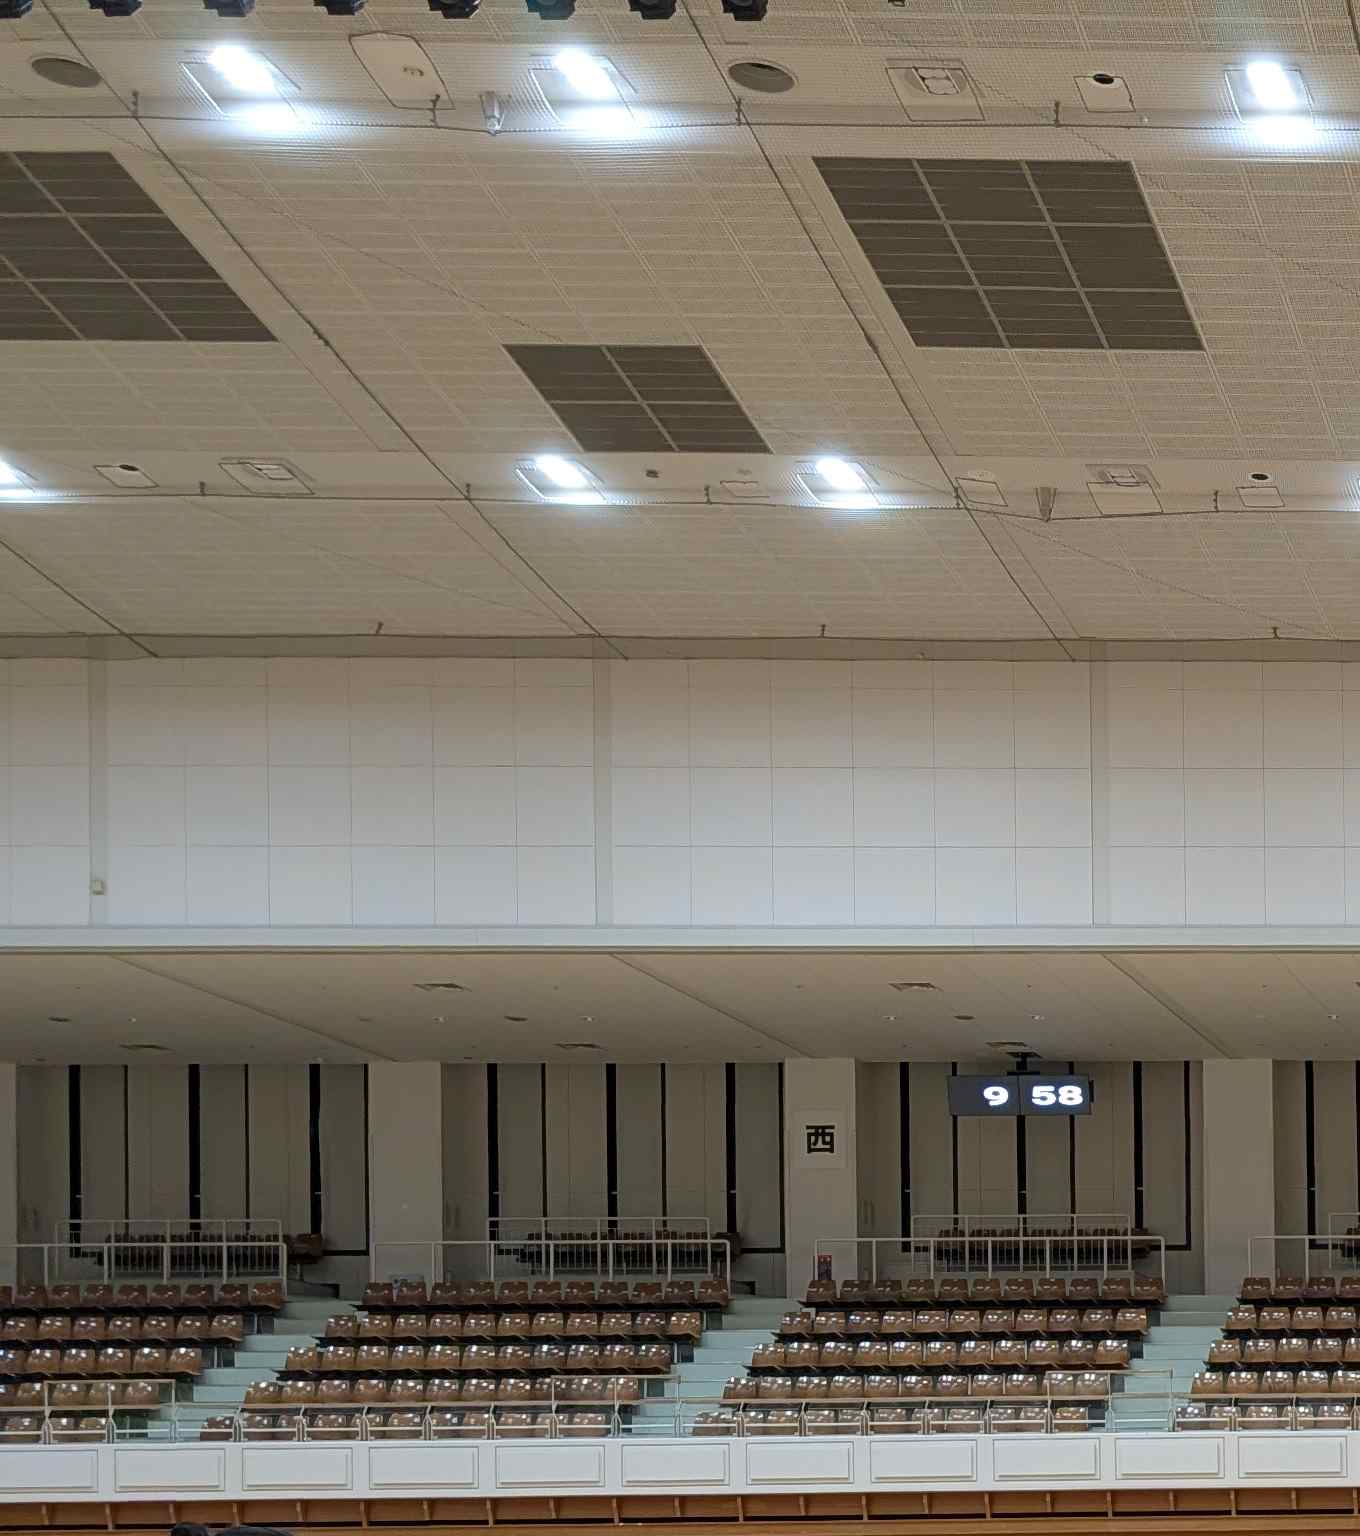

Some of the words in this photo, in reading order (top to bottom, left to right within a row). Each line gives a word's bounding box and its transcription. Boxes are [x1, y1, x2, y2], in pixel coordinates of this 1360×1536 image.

[982, 1085, 1010, 1107] 9
[1030, 1084, 1085, 1107] 58
[805, 1124, 837, 1155] 西
